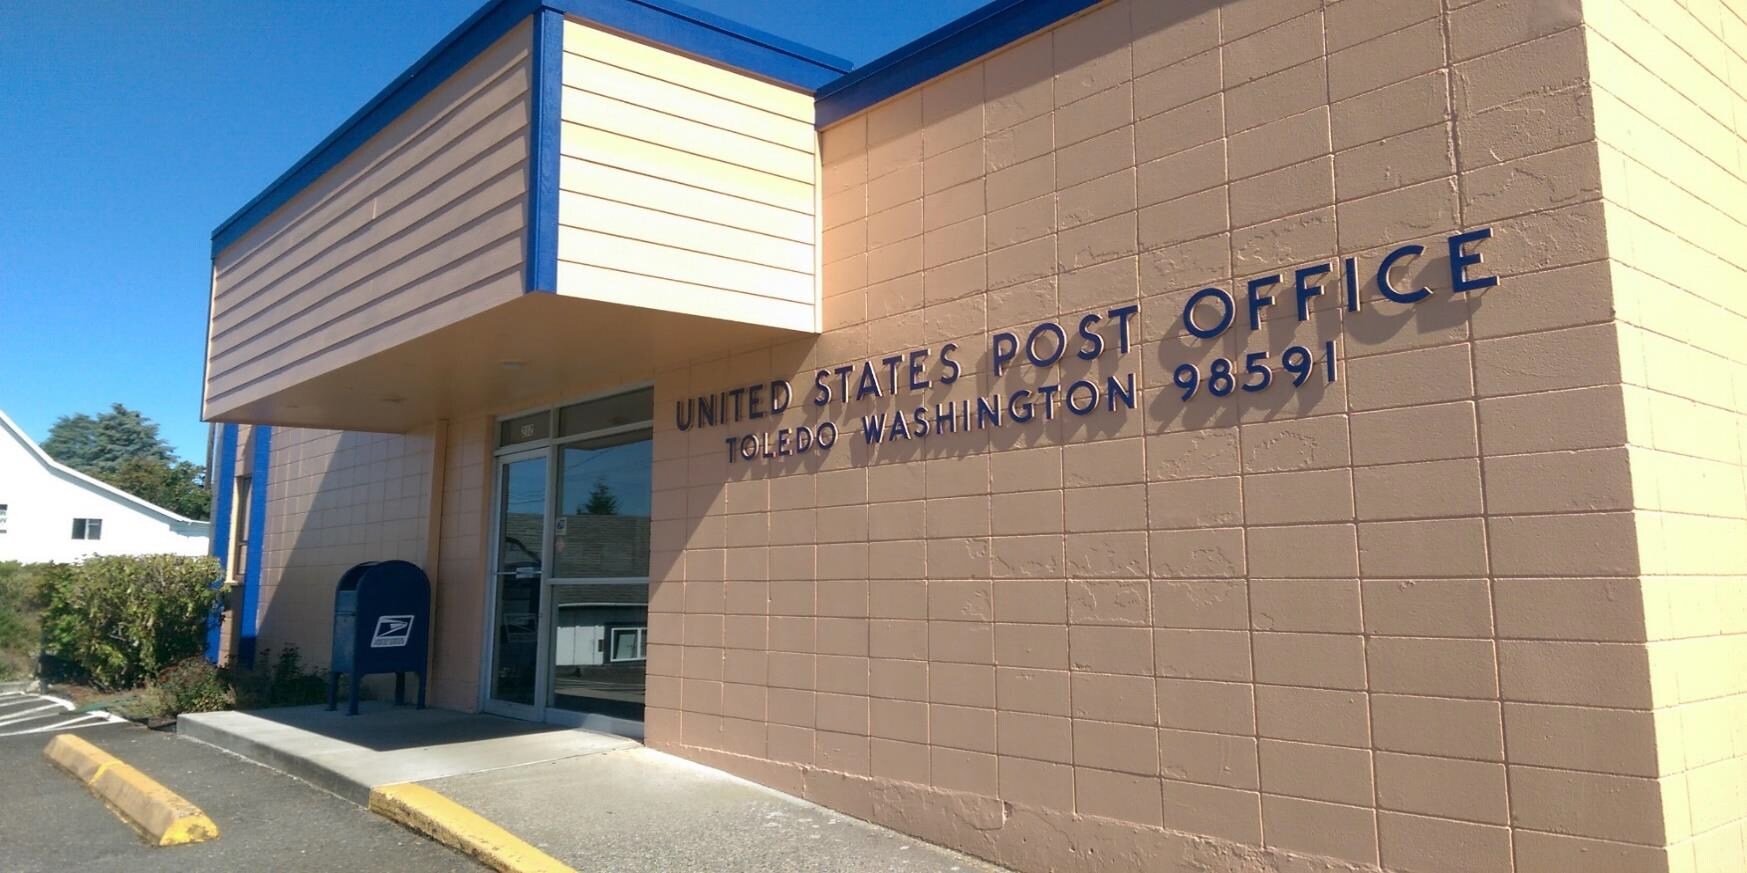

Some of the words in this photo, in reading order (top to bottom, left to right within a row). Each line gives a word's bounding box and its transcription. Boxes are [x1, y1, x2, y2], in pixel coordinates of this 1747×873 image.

[675, 380, 793, 431] UNITED
[814, 343, 961, 408] STATES
[992, 304, 1140, 377] POST
[1183, 227, 1501, 340] OFFICE
[725, 421, 839, 463] TOLEDO
[861, 372, 1137, 444] WASHINGTON
[1173, 340, 1338, 402] 98591
